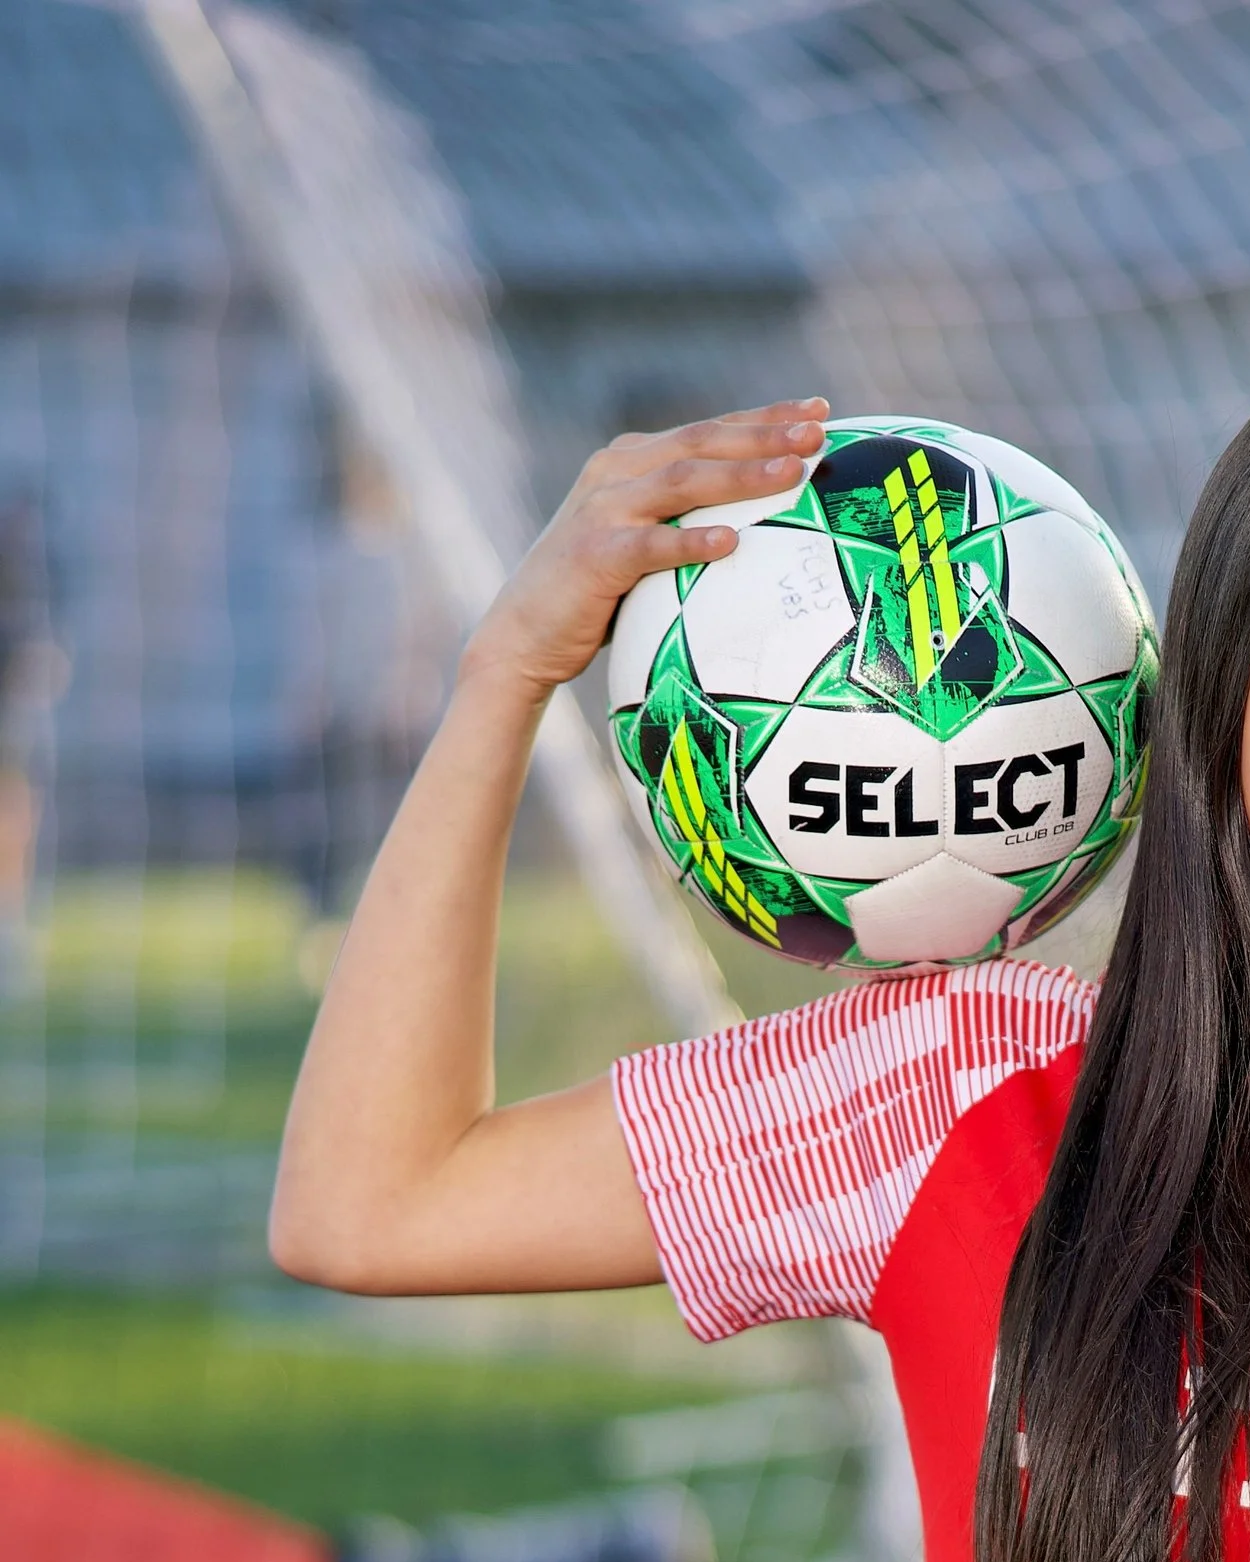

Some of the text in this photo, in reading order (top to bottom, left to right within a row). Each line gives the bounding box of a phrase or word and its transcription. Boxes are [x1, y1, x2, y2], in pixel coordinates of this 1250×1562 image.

[788, 741, 1086, 838] SELECT
[1005, 821, 1074, 845] CLUB DB
